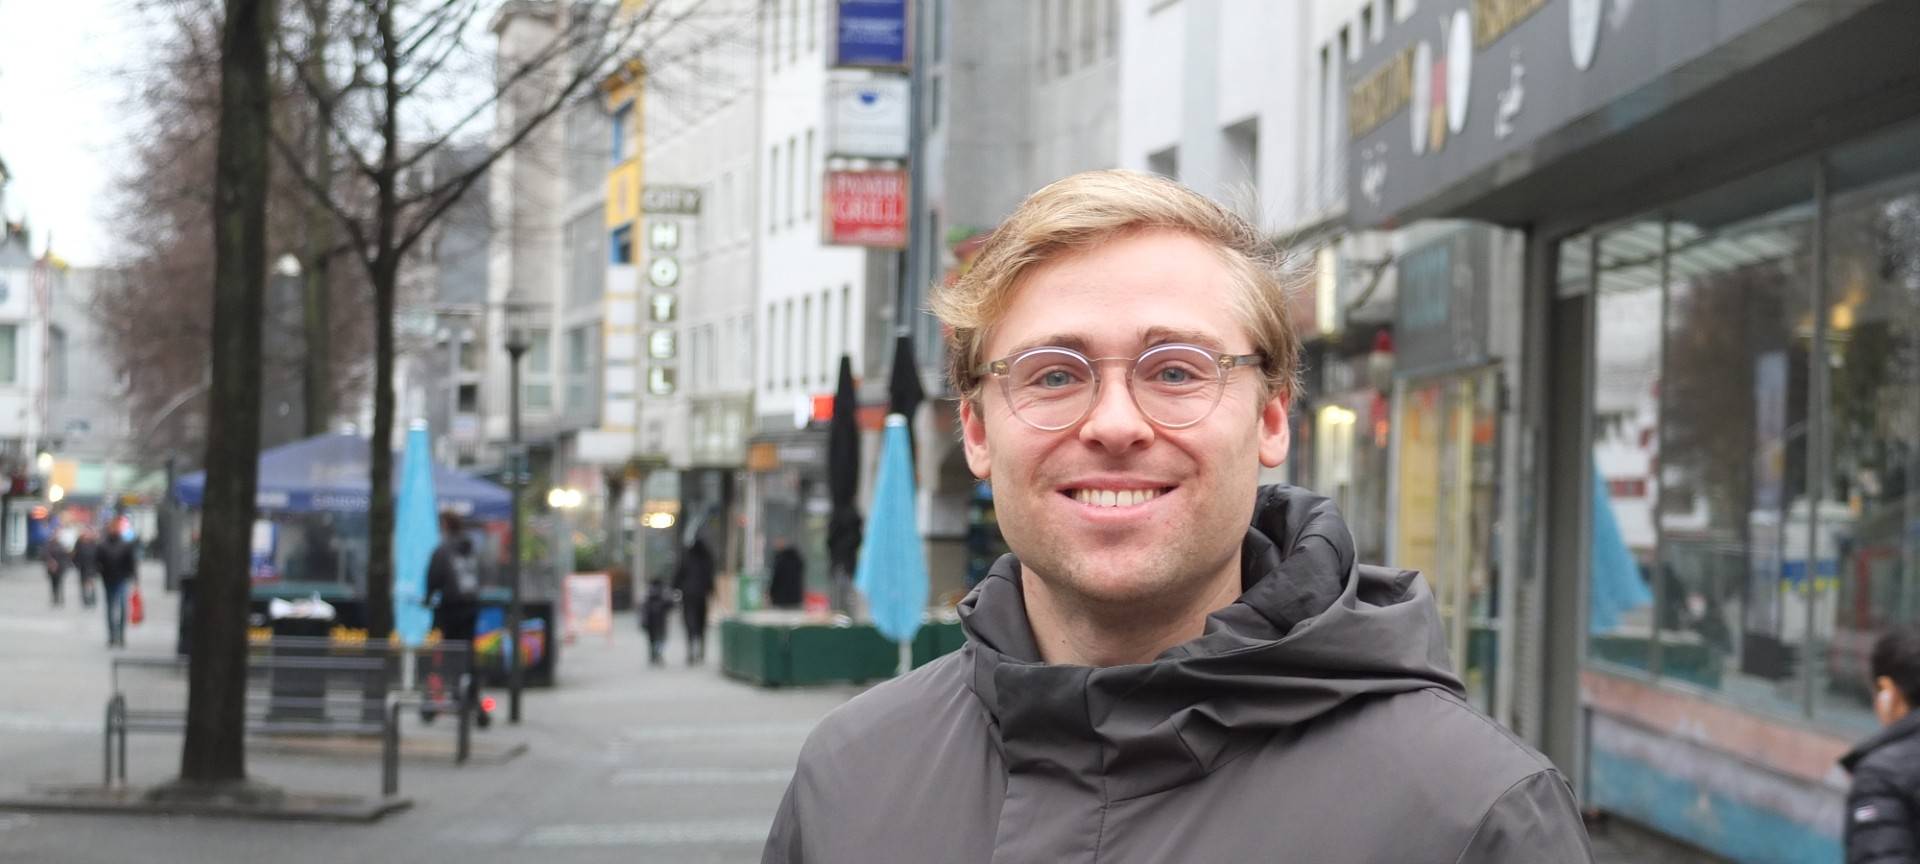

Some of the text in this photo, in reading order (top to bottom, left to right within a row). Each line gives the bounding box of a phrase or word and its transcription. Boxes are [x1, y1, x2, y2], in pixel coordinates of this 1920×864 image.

[643, 189, 699, 209] CITY
[834, 196, 904, 222] GRILL
[650, 223, 678, 396] HOTEL
